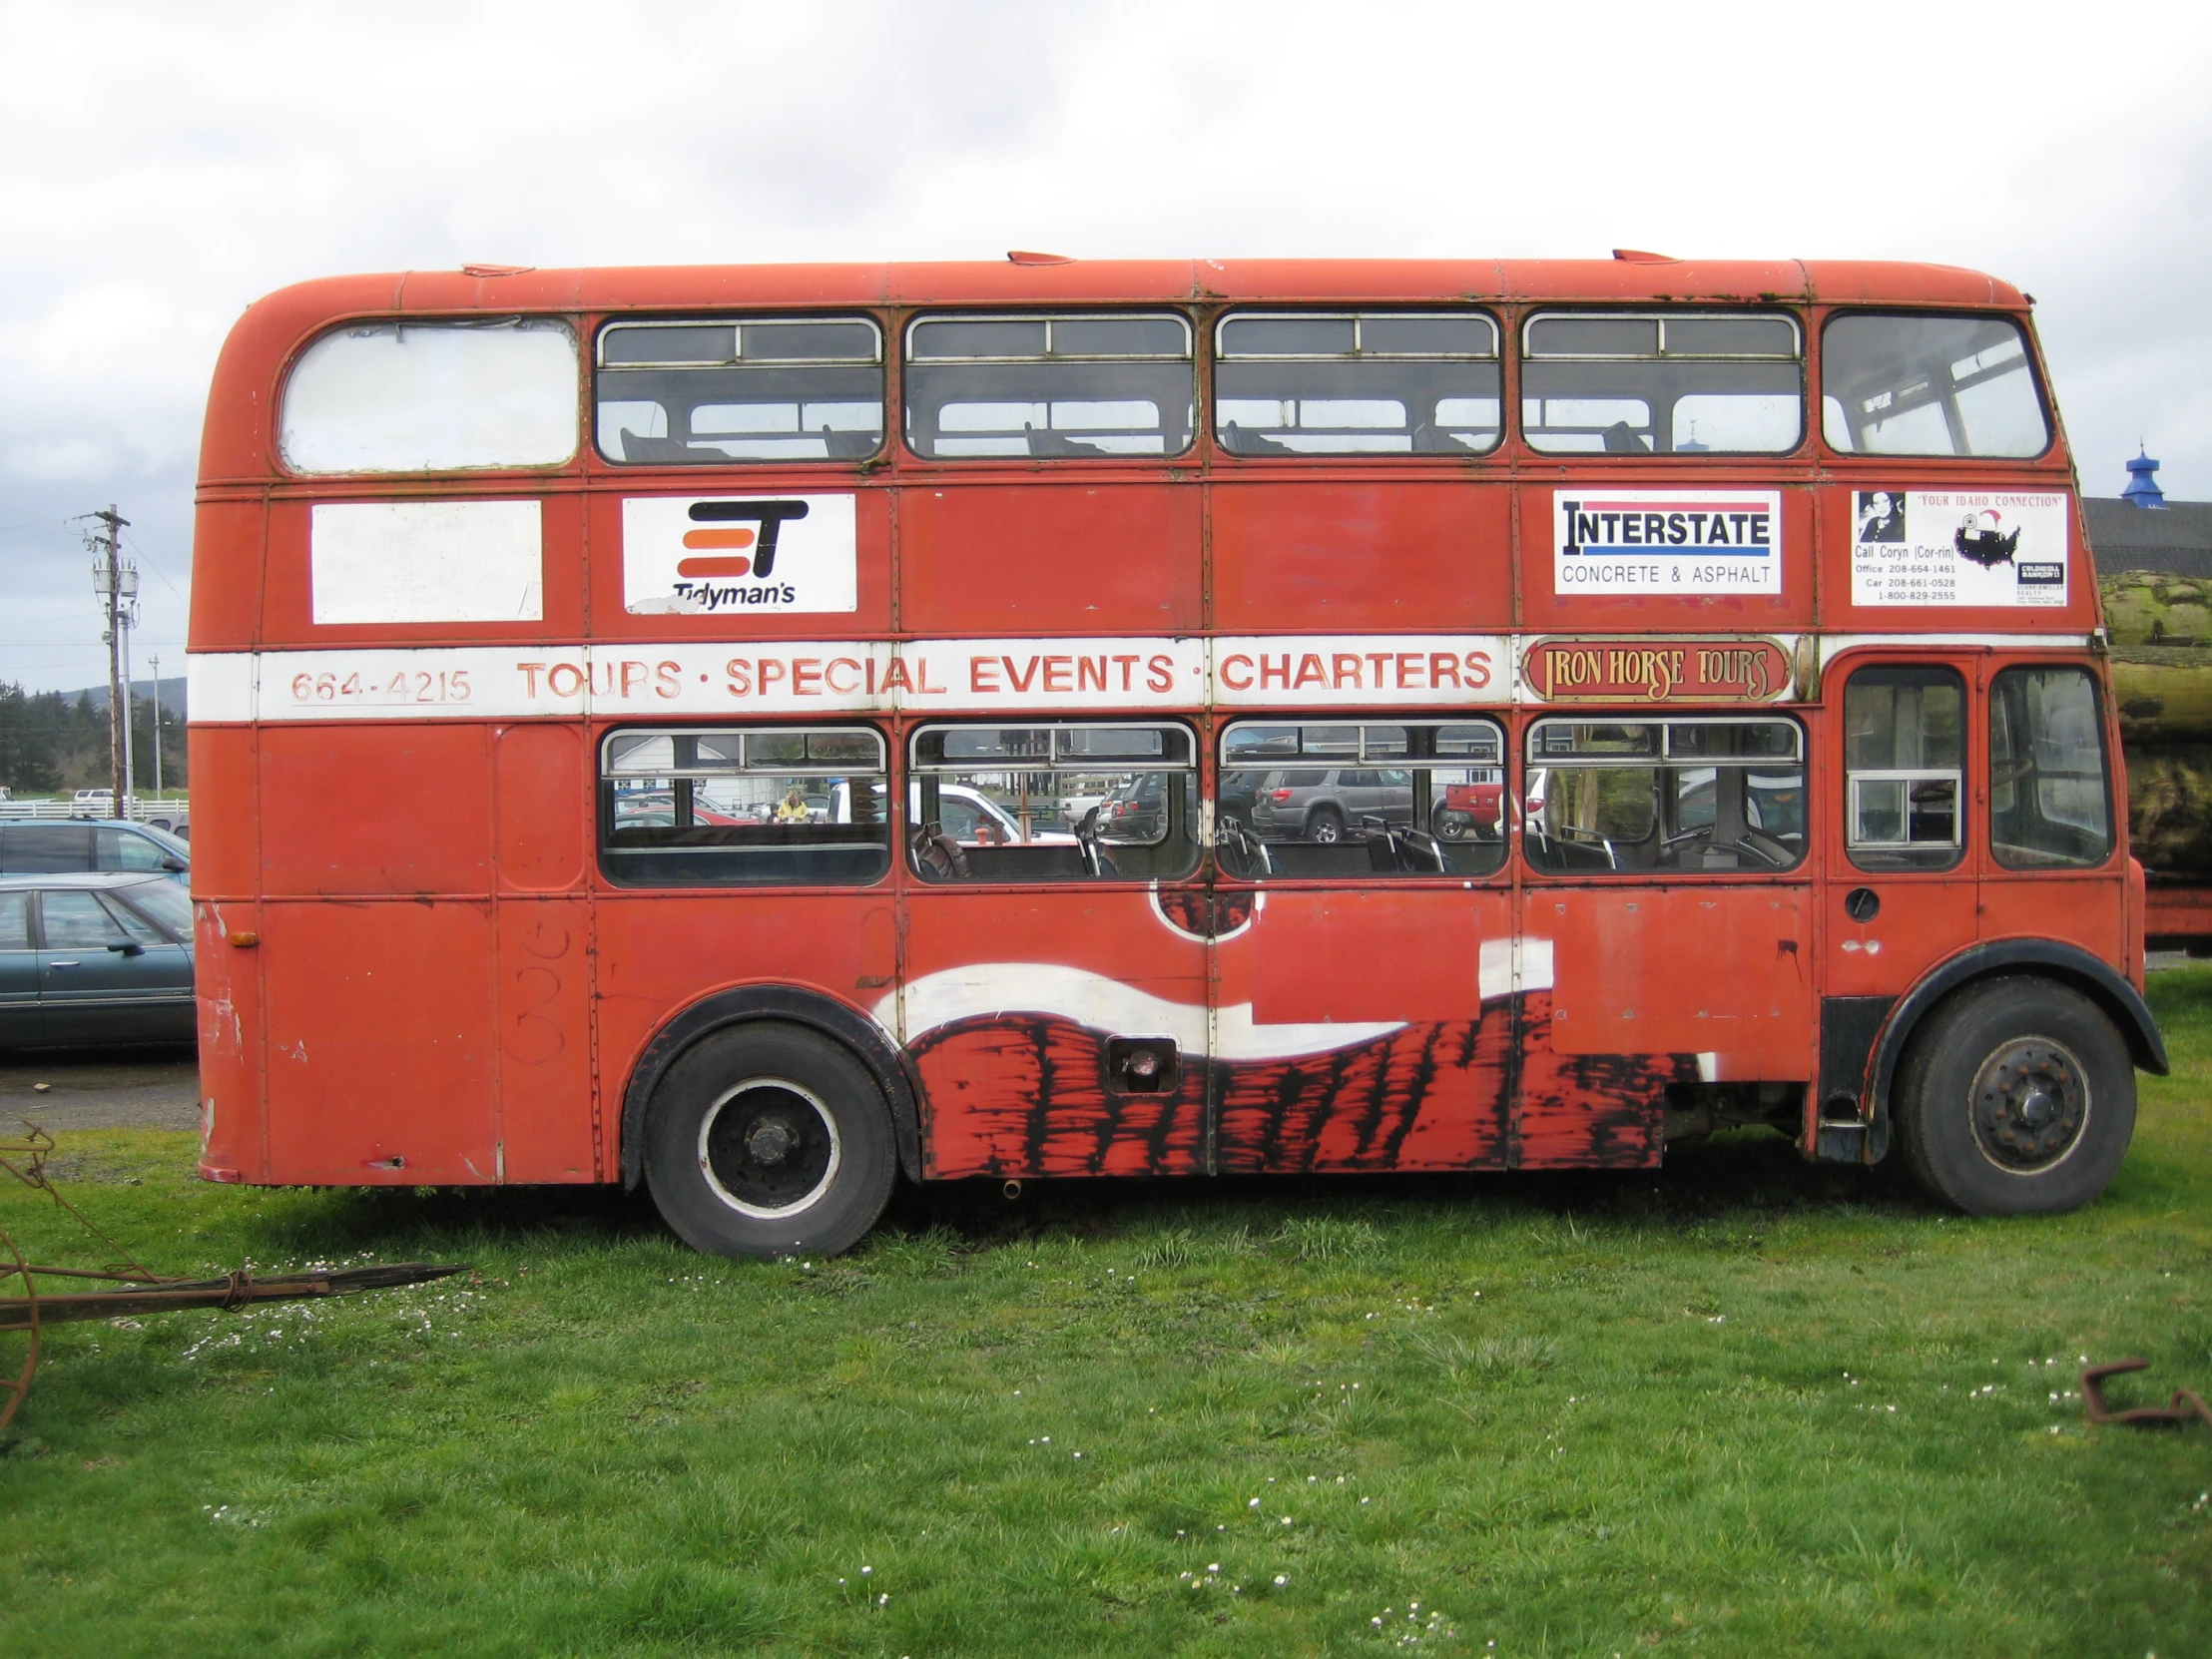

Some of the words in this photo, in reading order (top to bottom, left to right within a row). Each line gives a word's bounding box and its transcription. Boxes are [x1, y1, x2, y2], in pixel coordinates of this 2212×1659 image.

[1955, 495, 1988, 507] IDAHO
[1563, 501, 1770, 556] INTERSTATE
[1855, 546, 1874, 559] Call
[1880, 546, 1909, 562] Coryn
[1915, 546, 1954, 562] (Cor-rin)
[1562, 565, 1660, 583] CONCRETE
[1671, 566, 1682, 583] &
[1692, 566, 1771, 583] ASPHALT
[1856, 564, 1883, 574] Office
[1889, 564, 1956, 574] 208-664-1461
[1866, 578, 1882, 588] Car
[1888, 578, 1956, 588] 208-661-0528
[1879, 591, 1956, 601] 1-800-829-2555
[516, 660, 682, 699] TOURS
[726, 657, 947, 696] SPECIAL
[969, 654, 1175, 693] EVENTS
[1220, 651, 1491, 690] CHARTERS
[1545, 650, 1603, 701] IRON
[1608, 650, 1686, 702] HORSE
[1695, 650, 1769, 701] TOURS
[291, 671, 472, 702] 664-4215
